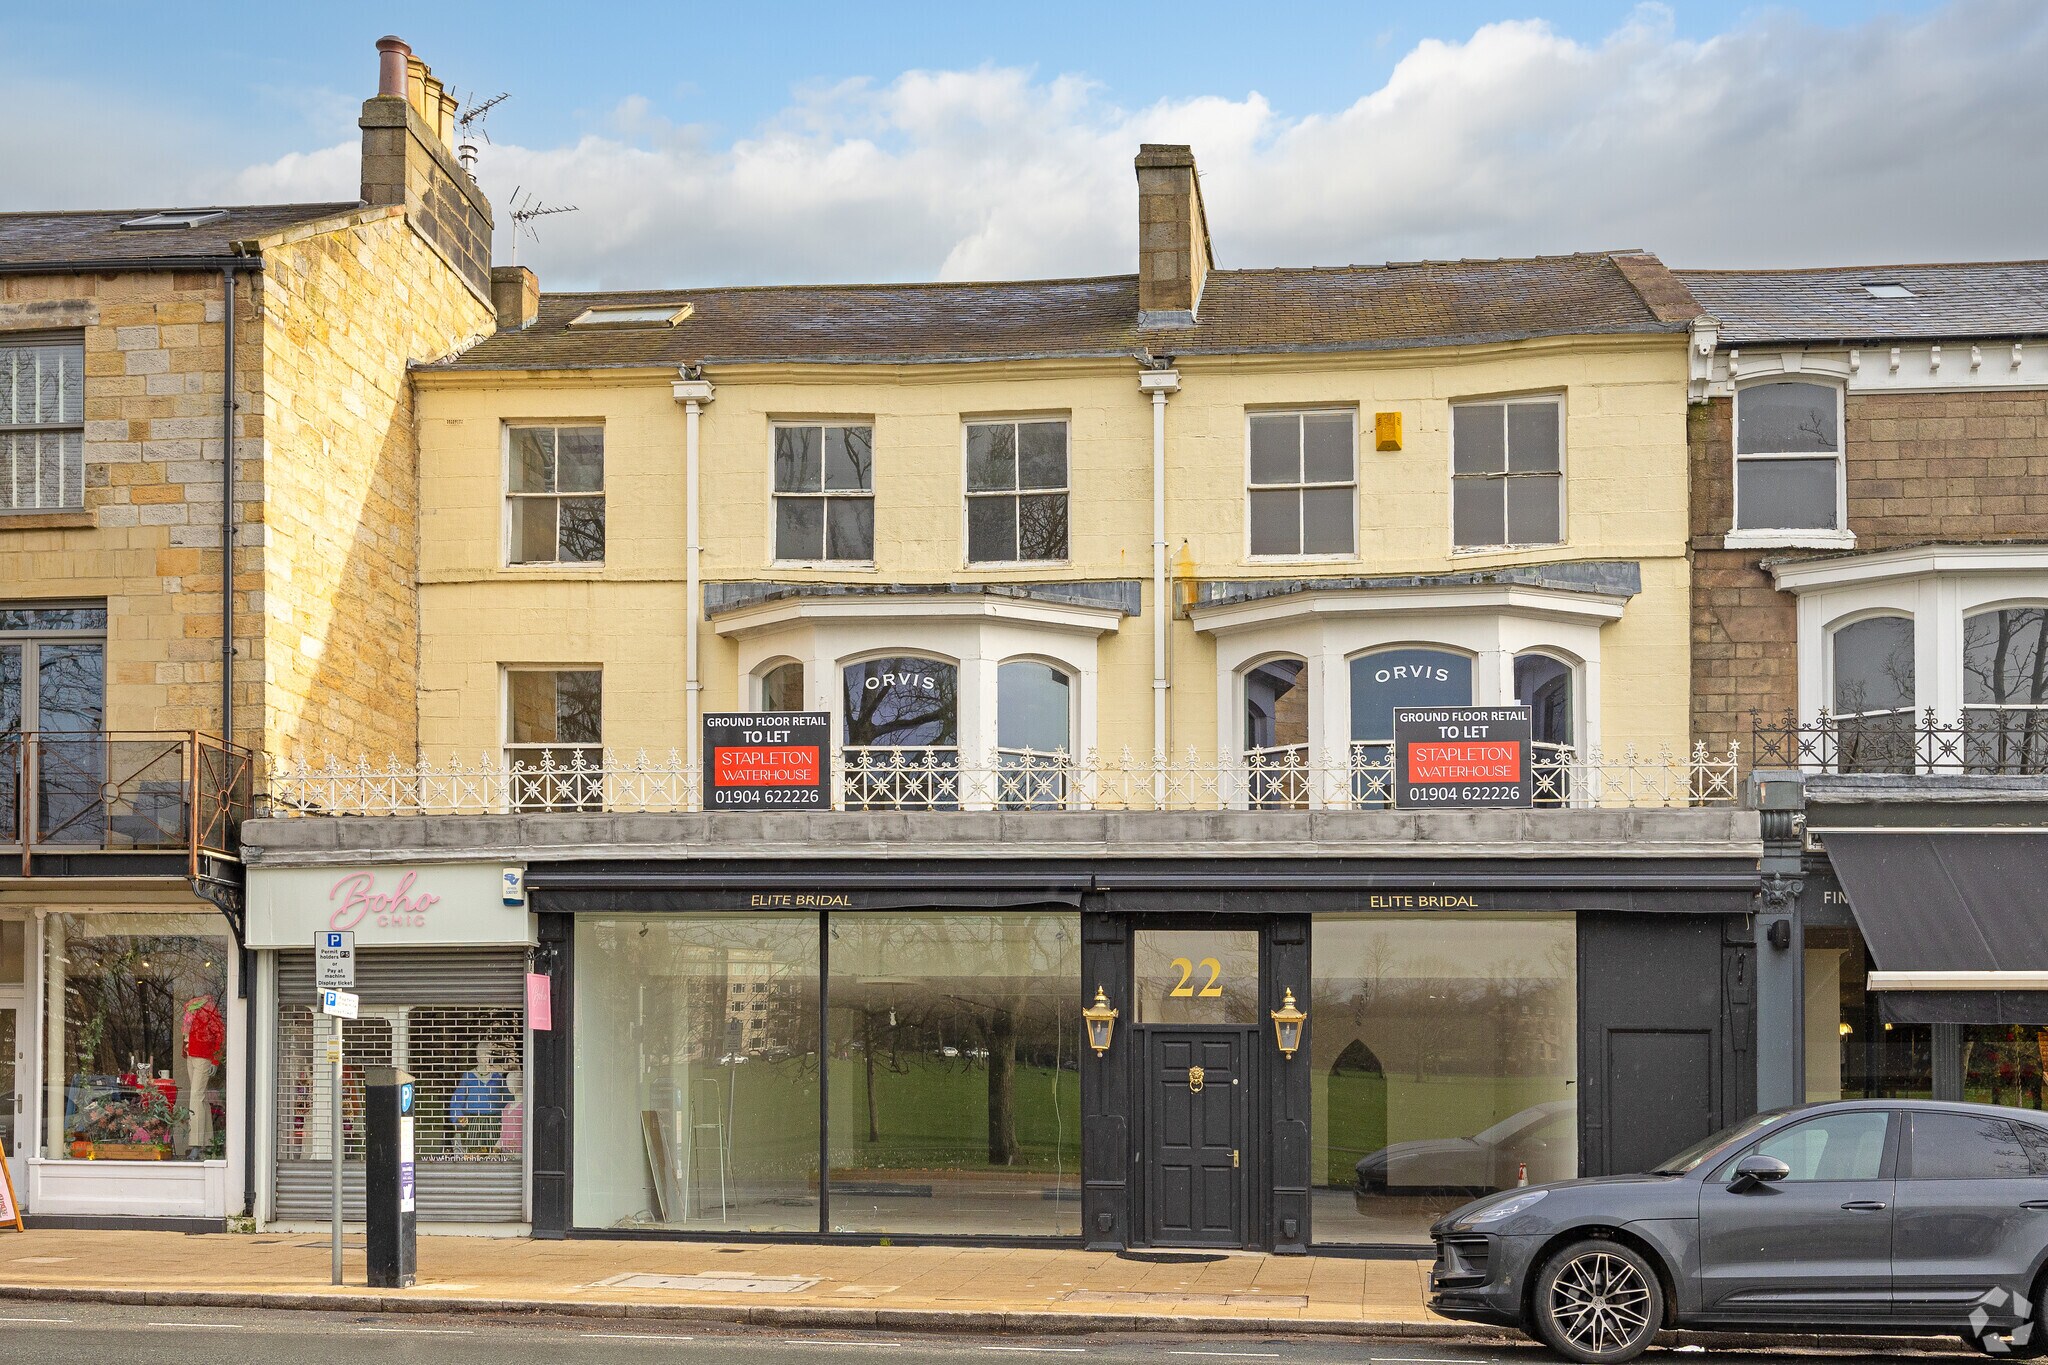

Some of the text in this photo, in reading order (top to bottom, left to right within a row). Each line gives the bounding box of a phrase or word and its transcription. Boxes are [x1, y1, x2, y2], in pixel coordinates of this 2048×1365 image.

[1375, 664, 1449, 683] ORVIS
[865, 672, 935, 690] ORVIS
[707, 716, 827, 727] GROUND FLOOR RETAIL
[1399, 711, 1527, 722] GROUND FLOOR RETAIL
[743, 730, 791, 743] TO LET
[1438, 725, 1489, 739] TO LET
[721, 751, 813, 765] STAPLETON
[1416, 747, 1513, 762] STAPLETON
[722, 768, 812, 781] WATERHOUSE
[1417, 765, 1512, 778] WATERHOUSE
[715, 789, 819, 803] 01904 622226
[1409, 786, 1520, 801] 01904 622226
[329, 870, 441, 931] Boho
[751, 894, 852, 906] ELITE BRIDAL
[1370, 895, 1478, 907] ELITE BRIDAL
[377, 914, 425, 927] CHIC
[330, 934, 340, 946] P
[1169, 957, 1223, 997] 22
[327, 993, 335, 1005] P
